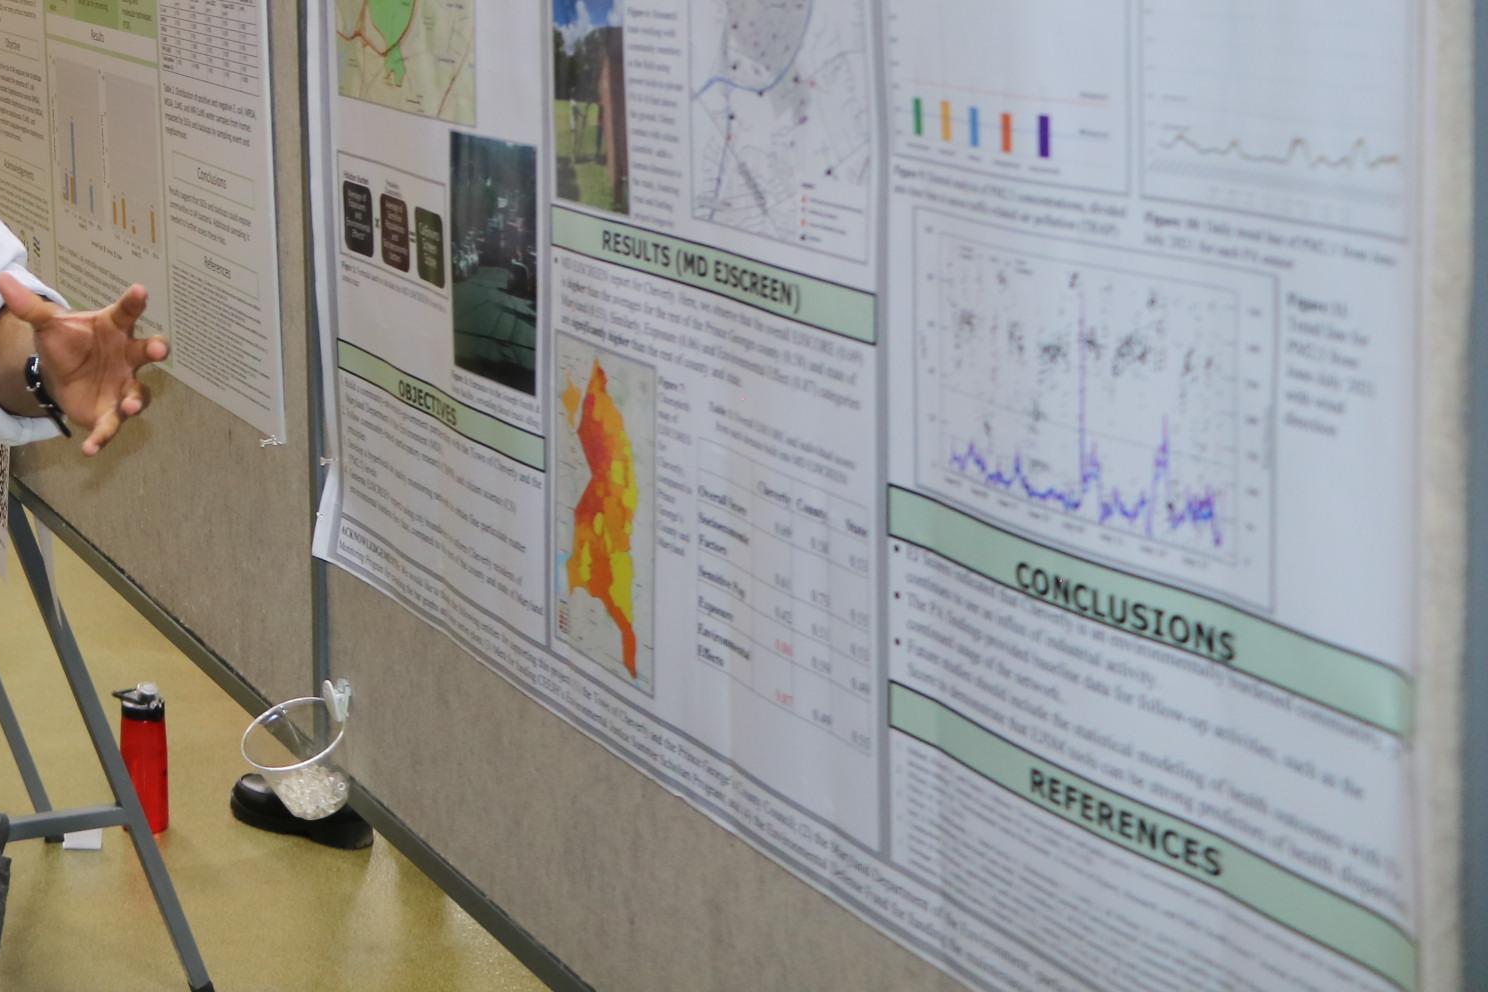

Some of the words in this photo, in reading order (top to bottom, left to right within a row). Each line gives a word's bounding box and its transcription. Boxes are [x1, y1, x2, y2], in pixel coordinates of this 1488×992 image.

[602, 229, 671, 268] RESULTS
[675, 247, 708, 278] (MD
[714, 259, 801, 314] EJSCREEN)
[398, 379, 457, 427] OBJECTIVES
[1015, 562, 1235, 661] CONCLUSIONS
[1028, 768, 1223, 878] REFERENCES
